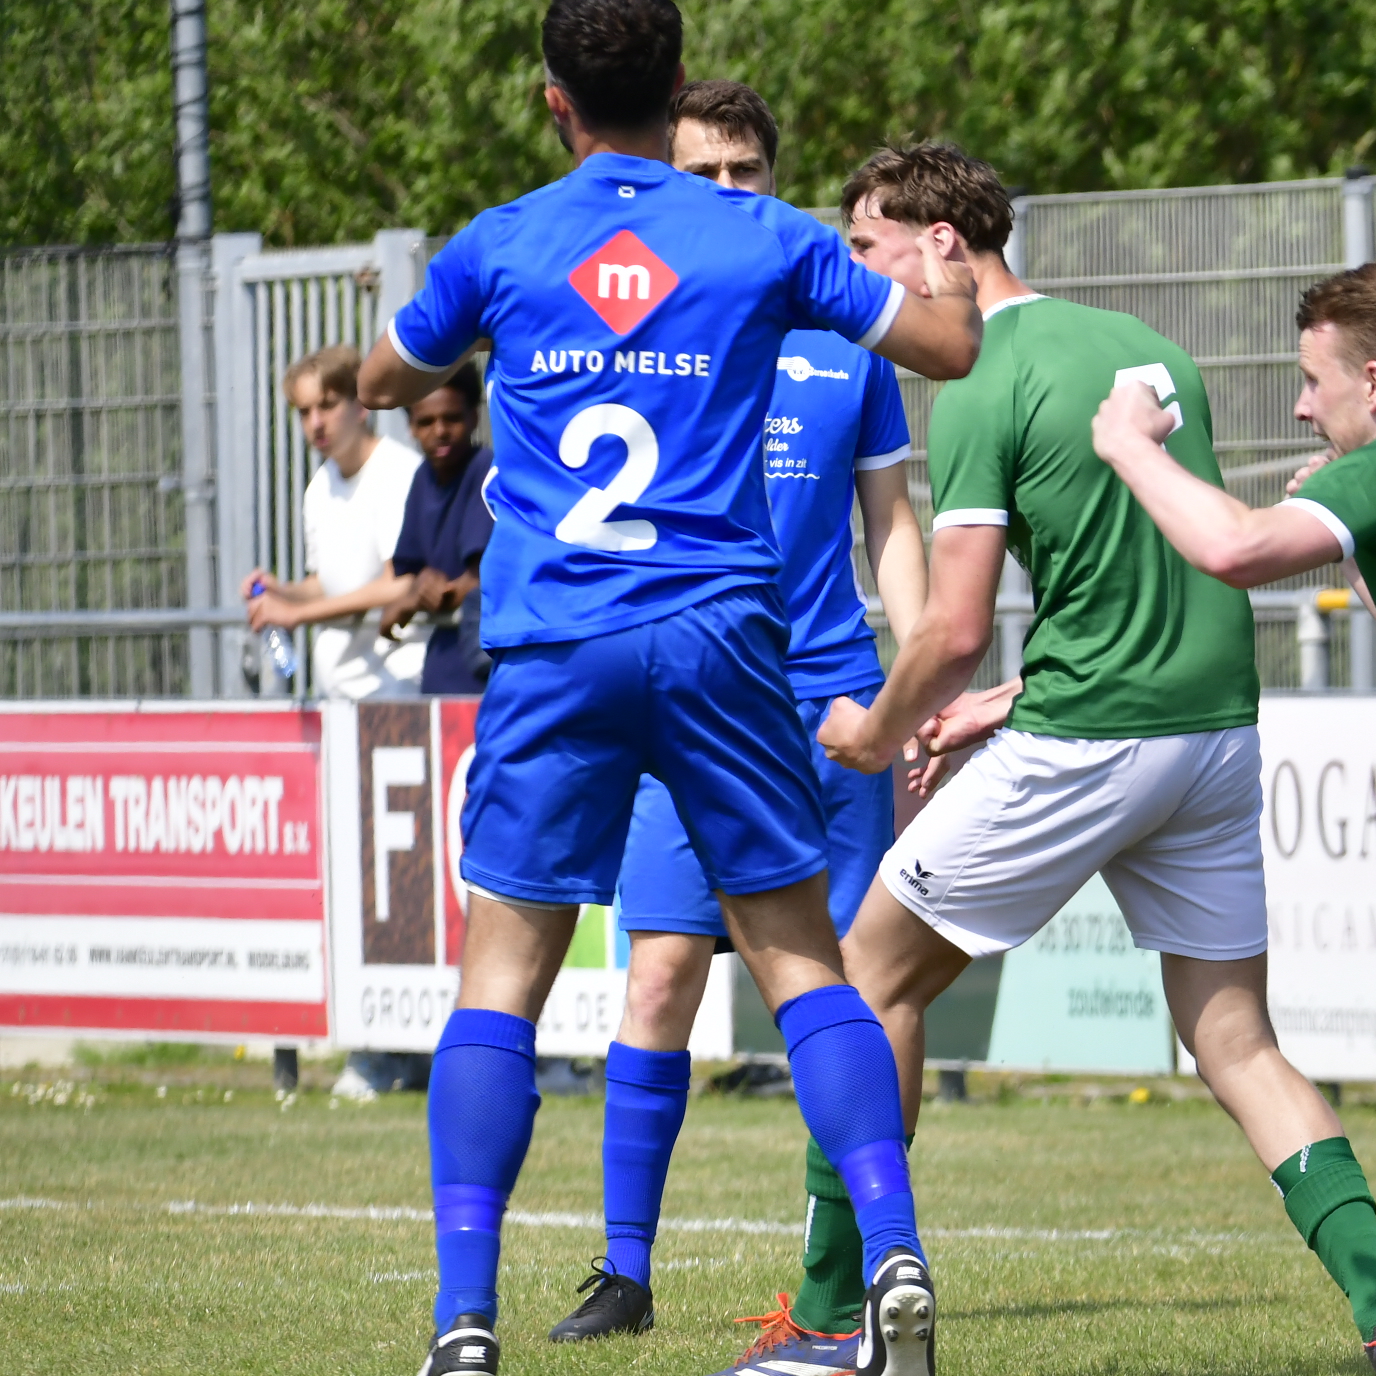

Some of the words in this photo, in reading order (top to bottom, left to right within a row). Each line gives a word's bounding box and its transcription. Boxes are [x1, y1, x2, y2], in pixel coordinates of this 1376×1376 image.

[597, 262, 651, 300] m
[530, 349, 605, 374] AUTO
[614, 350, 712, 377] MELSE
[555, 403, 660, 552] 2
[0, 775, 105, 852] KEULEN
[109, 774, 284, 855] TRANSPORT
[899, 868, 929, 896] erima
